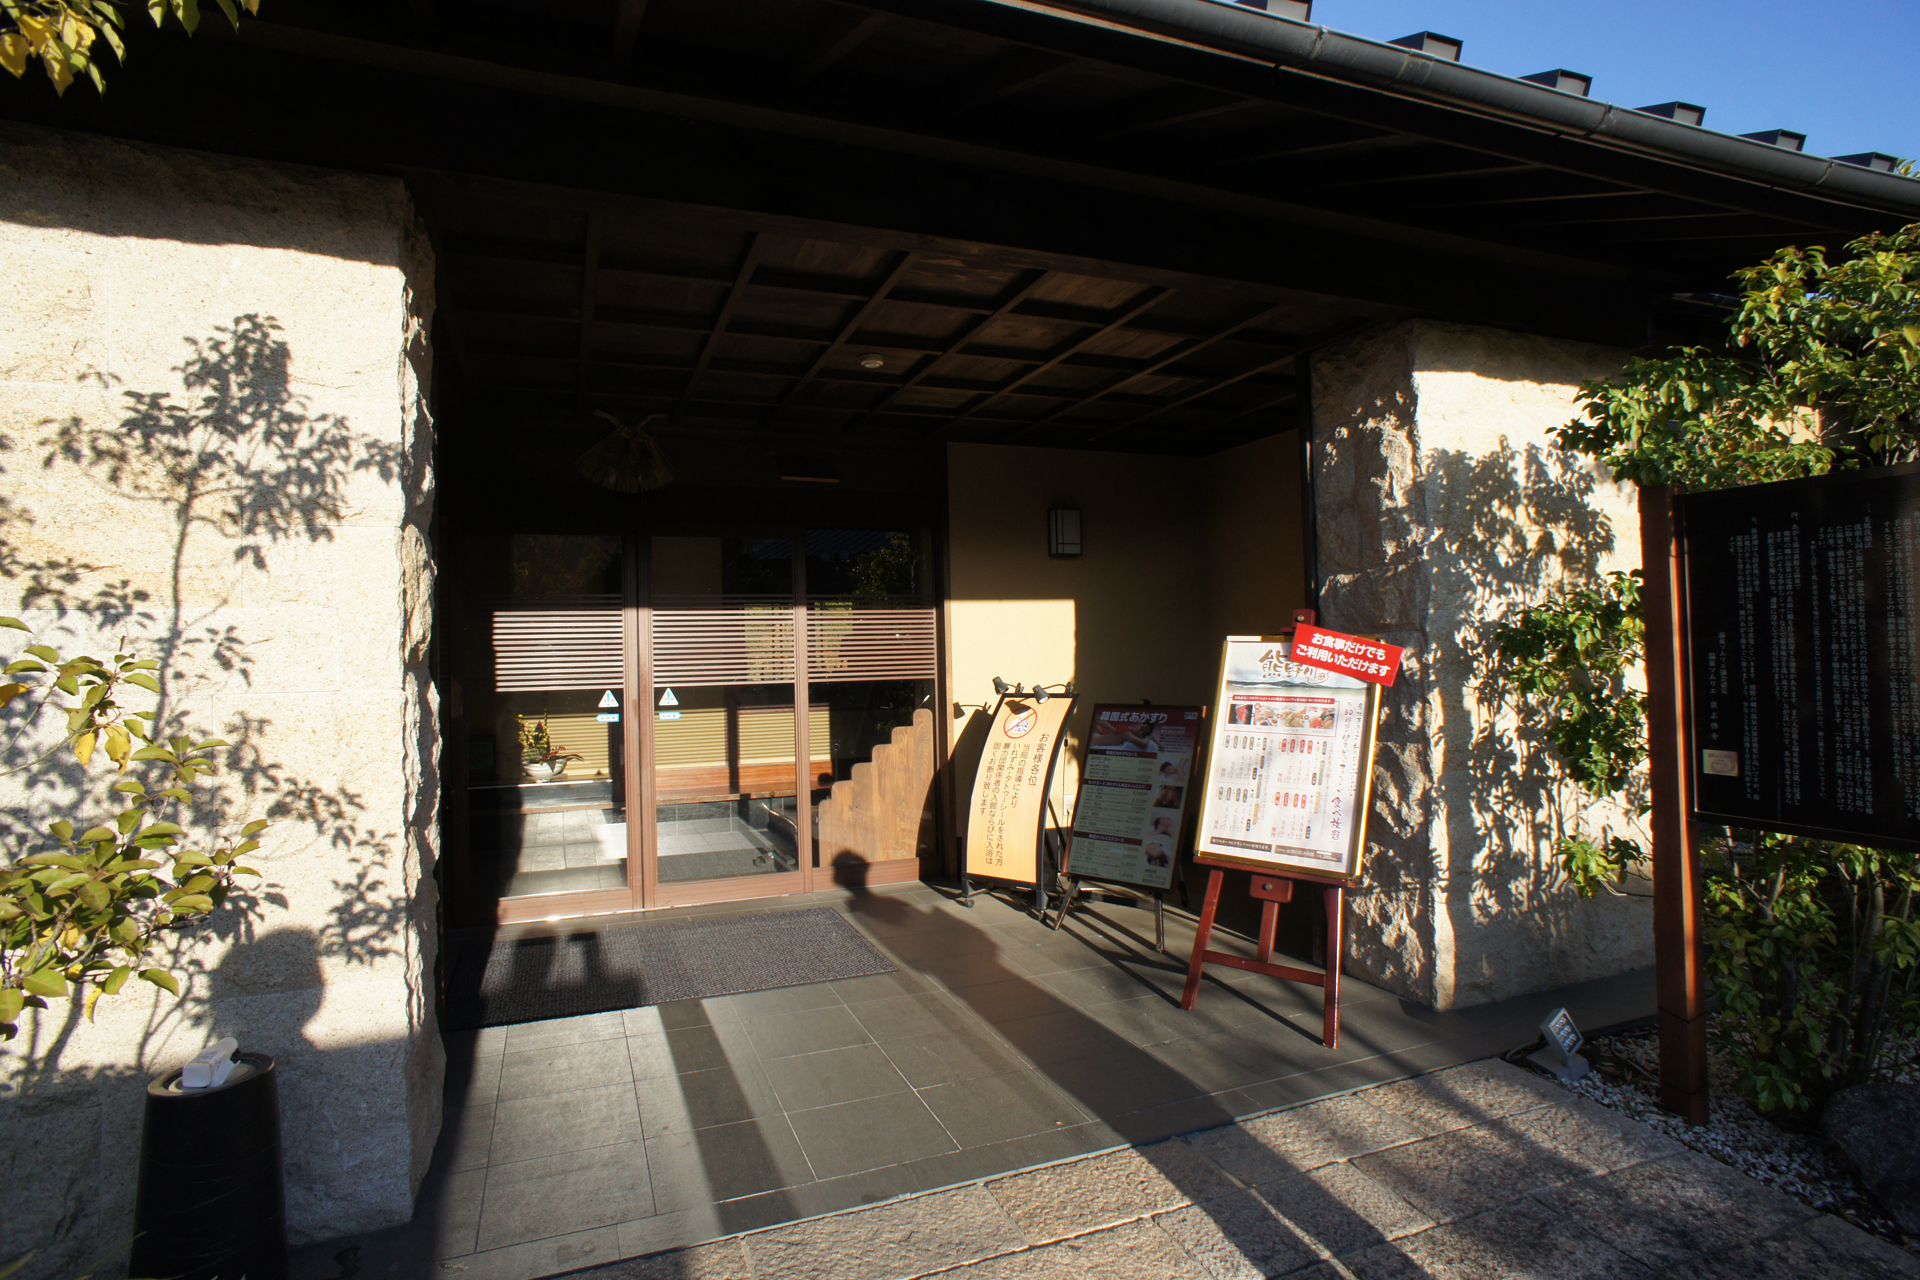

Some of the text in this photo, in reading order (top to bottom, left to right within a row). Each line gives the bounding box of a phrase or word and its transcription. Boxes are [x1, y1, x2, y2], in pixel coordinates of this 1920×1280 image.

[1296, 643, 1391, 678] ご利用いただけます
[1311, 632, 1386, 661] お食事だけでも
[1100, 711, 1168, 724] 韓国式あかすり
[979, 742, 1002, 815] 固くお断り致します
[1010, 743, 1031, 808] 当局の指導により
[1028, 733, 1049, 787] お客様各位
[985, 742, 1011, 865] 暴力団関係者の入館ならびに入浴は
[995, 742, 1020, 866] いれずみ・タトゥーシールをされた方
